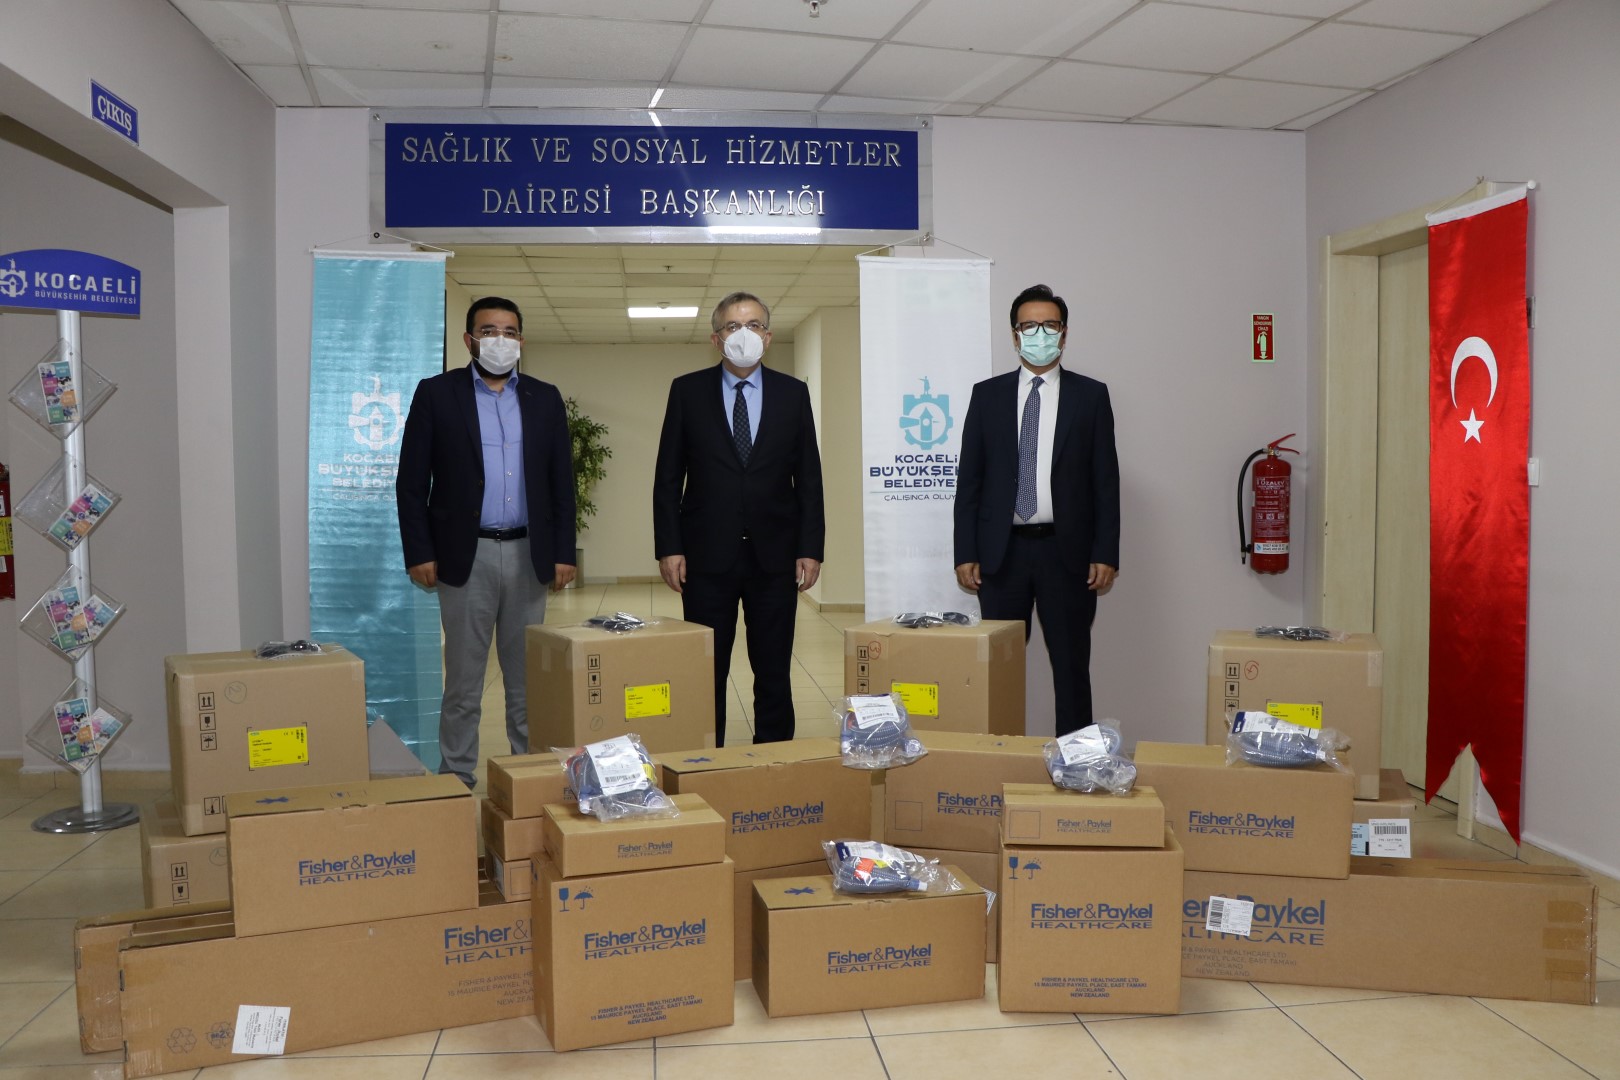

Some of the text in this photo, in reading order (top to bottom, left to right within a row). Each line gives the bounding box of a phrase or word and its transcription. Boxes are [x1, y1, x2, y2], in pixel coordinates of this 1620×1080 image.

[97, 95, 133, 136] ÇIKIŞ
[402, 131, 901, 167] SAĞLIK VE SOSYAL HİZMETLER
[482, 183, 826, 217] DAİRESİ BAŞKANLIĞI
[34, 272, 136, 294] KOCAELİ
[91, 294, 136, 305] BELEDİYESİ
[895, 454, 958, 463] KOCAELİ
[884, 479, 957, 488] BELEDİYE
[884, 493, 956, 502] ÇALIŞINCA OLUY
[937, 806, 1001, 817] HEALTHC
[732, 815, 824, 834] HEALTHCARE
[1188, 826, 1294, 838] HEALTHCARE
[299, 866, 416, 886] HEALTHCARE
[1031, 921, 1153, 929] HEALTHCARE
[584, 936, 706, 960] HEALTHCARE
[445, 946, 533, 965] HEALTH
[828, 959, 931, 975] HEALTHCARE
[598, 1006, 619, 1014] FISHER
[647, 997, 684, 1006] HEALTHCARE
[597, 1012, 622, 1020] MAURICE
[623, 1008, 645, 1016] PAYKEL
[632, 1010, 663, 1019] AUCKLAND
[641, 1015, 667, 1023] ZEALAND
